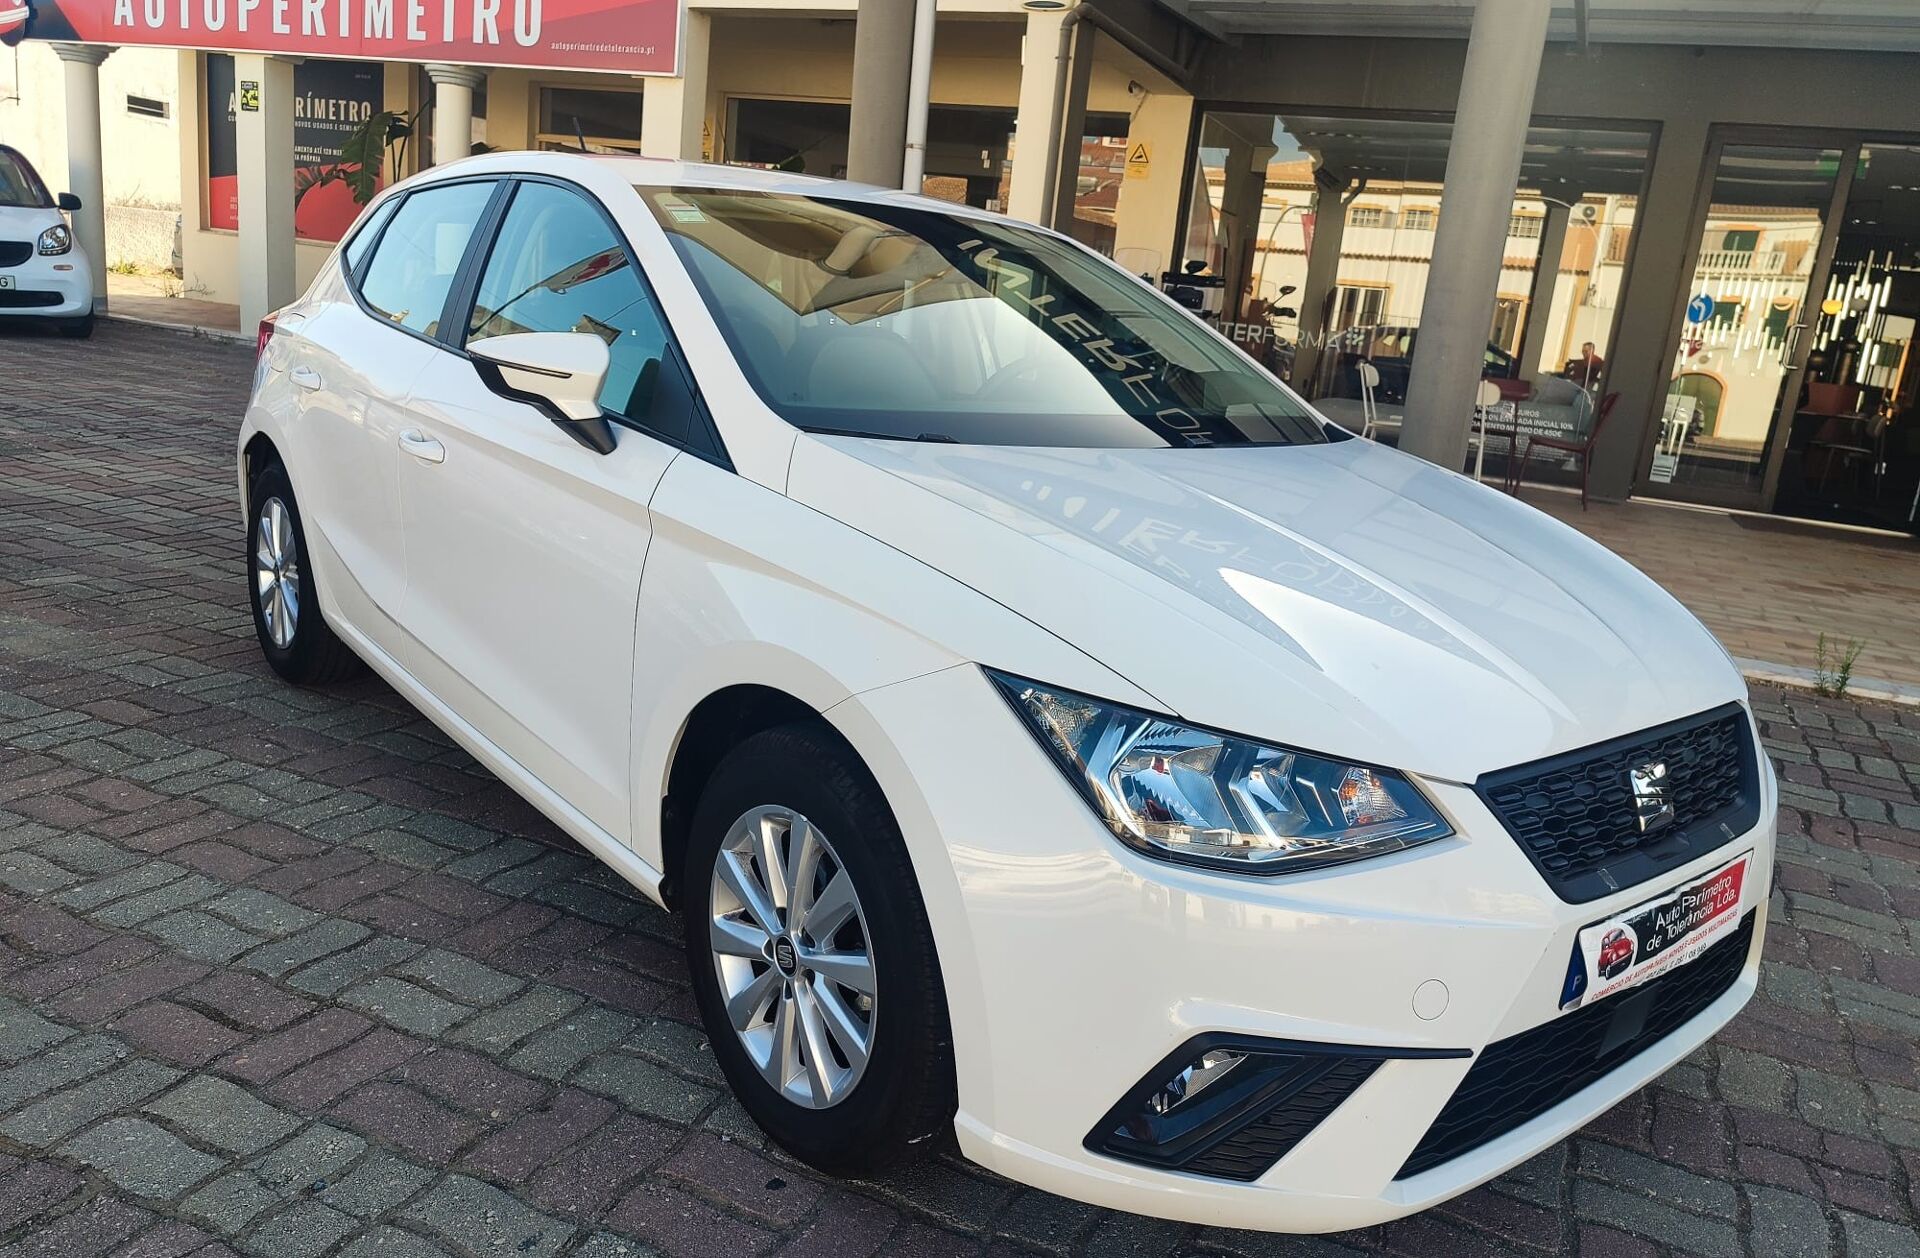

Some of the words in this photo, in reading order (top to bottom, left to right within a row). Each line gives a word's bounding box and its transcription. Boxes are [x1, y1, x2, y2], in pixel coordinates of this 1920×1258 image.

[1645, 934, 1662, 952] de
[1716, 888, 1737, 909] Lda.
[1655, 906, 1681, 931] Auto
[1681, 875, 1732, 914] Perímetro
